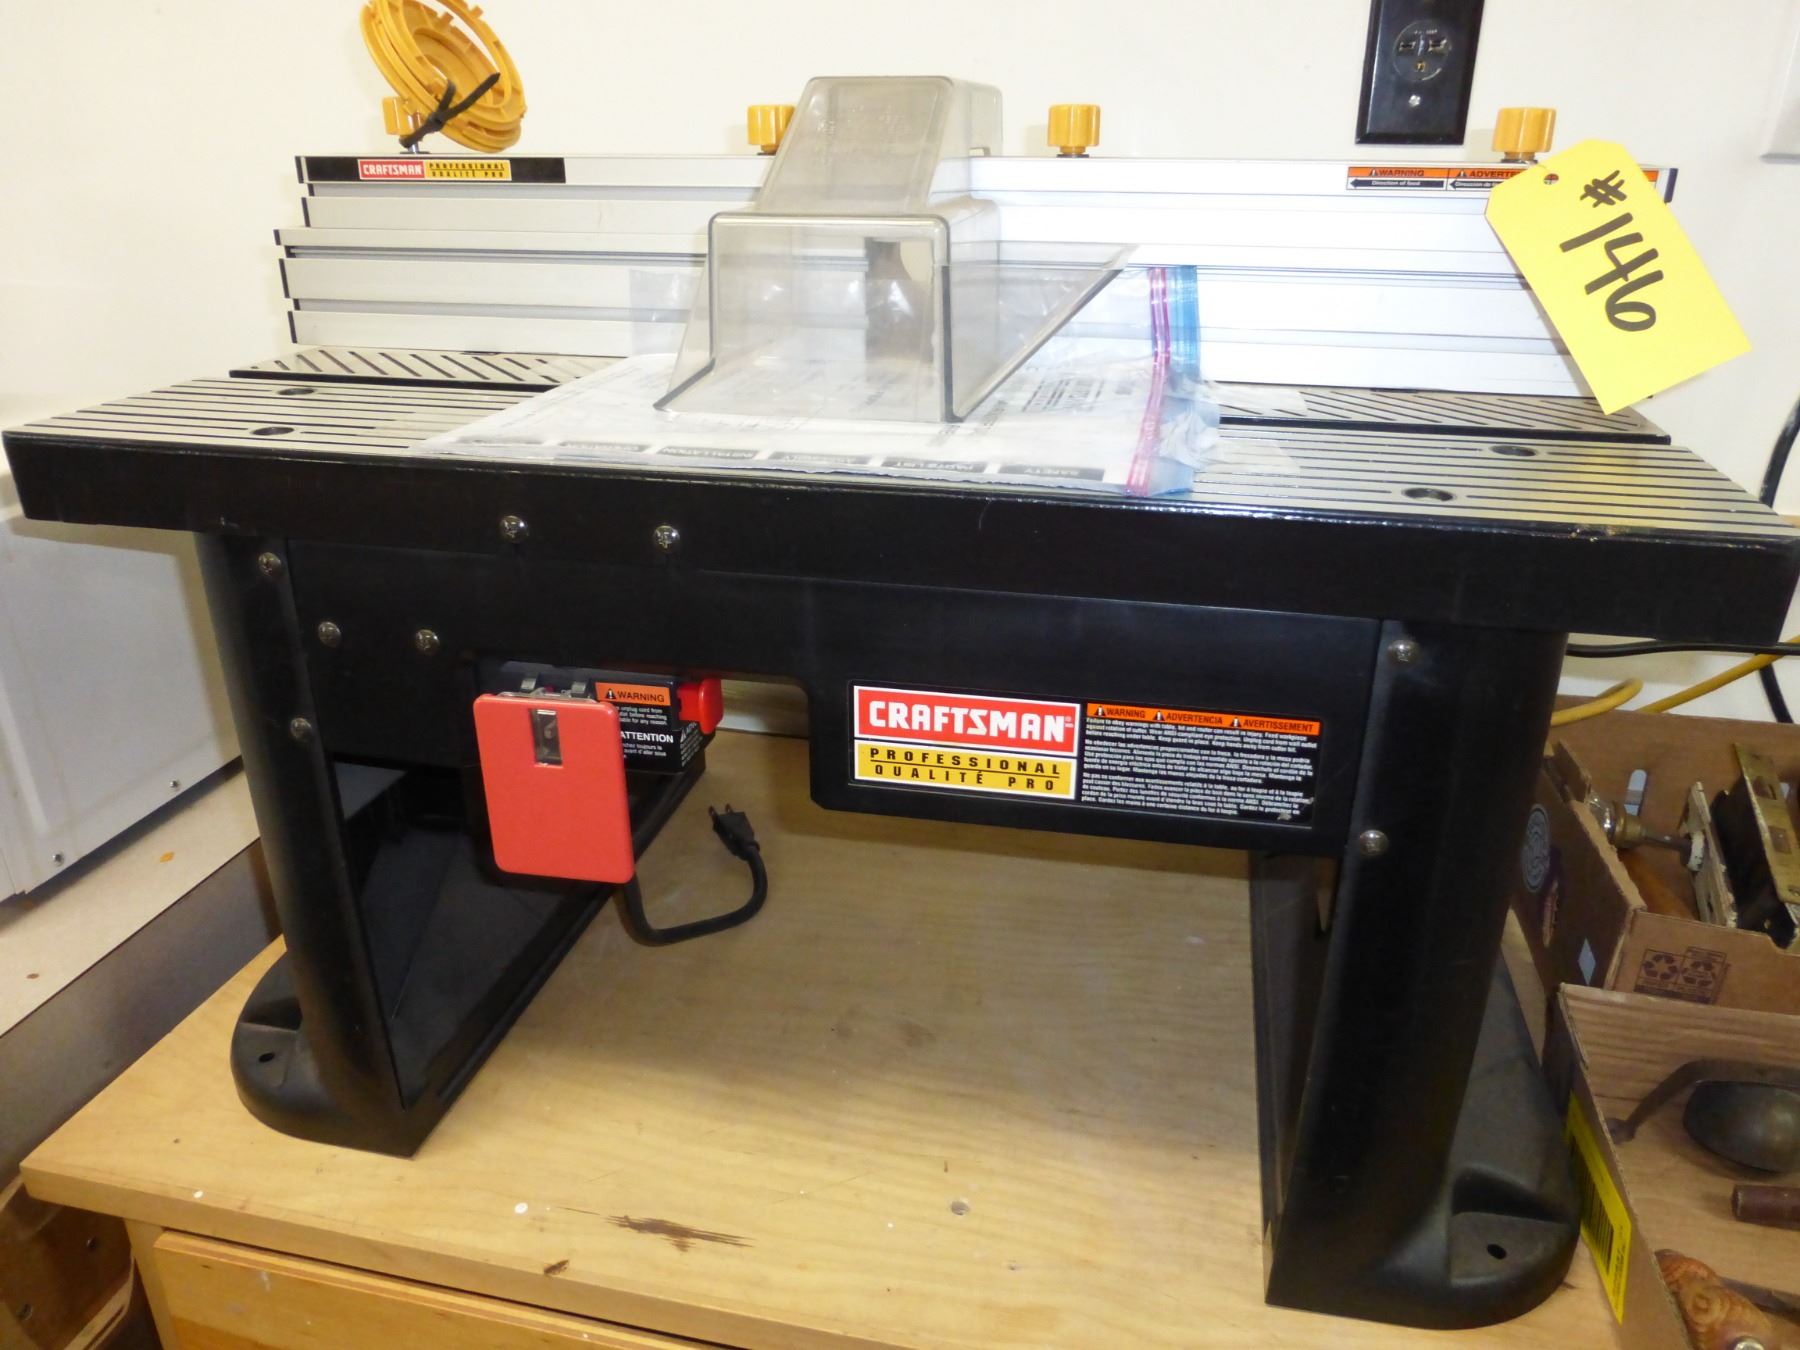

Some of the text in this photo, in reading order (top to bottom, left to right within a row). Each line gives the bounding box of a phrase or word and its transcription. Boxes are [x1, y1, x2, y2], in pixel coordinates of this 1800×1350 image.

[363, 164, 422, 176] CRAFTSMAN
[1378, 169, 1424, 177] WARNING
[618, 690, 664, 702] WARNING
[1106, 707, 1145, 718] WARNING
[1166, 712, 1222, 724] ADVERTENCIA
[870, 700, 1064, 742] CRAFTSMAN
[1243, 718, 1313, 732] AVERTISSEMENT
[621, 731, 674, 743] ATTENTION
[870, 748, 1060, 775] PROFESSIONAL
[875, 764, 1054, 791] QUALITÉ PRO
